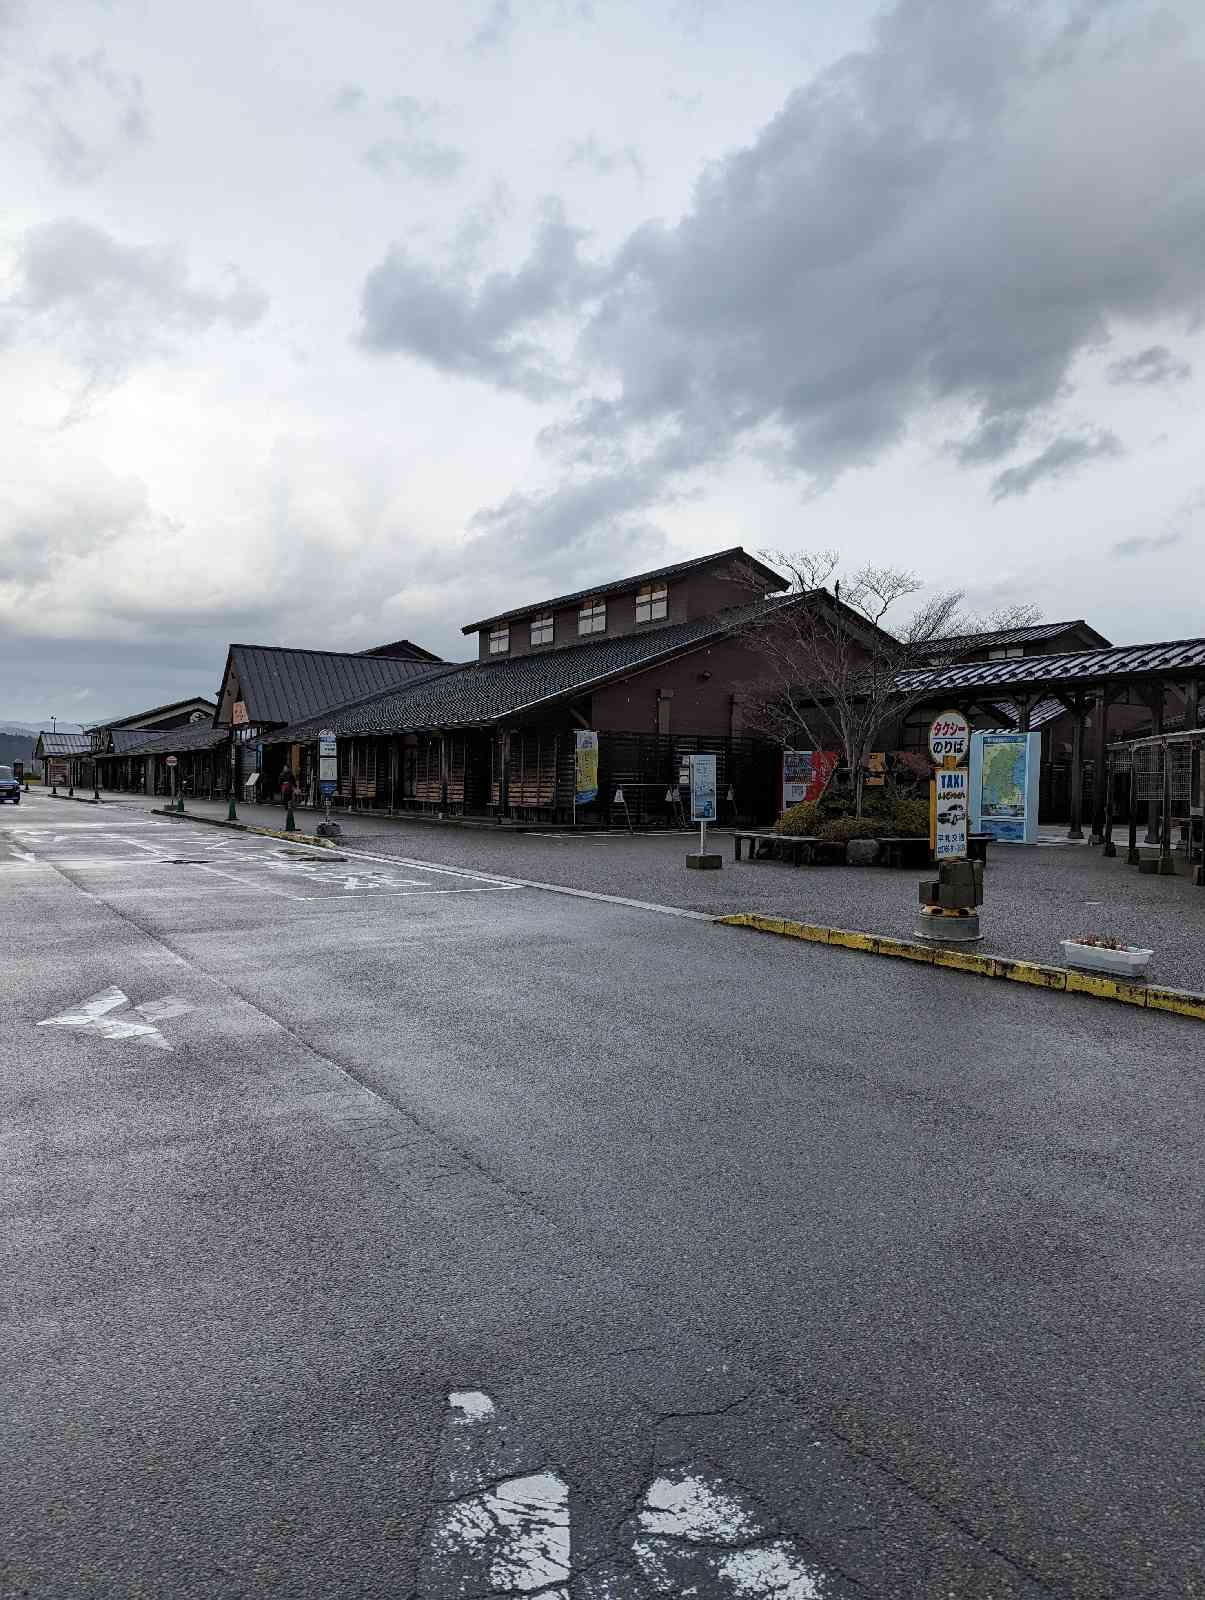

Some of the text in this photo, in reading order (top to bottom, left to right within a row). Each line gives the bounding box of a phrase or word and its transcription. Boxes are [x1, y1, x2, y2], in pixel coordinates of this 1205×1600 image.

[934, 721, 965, 736] タクシー
[933, 740, 964, 754] のりば
